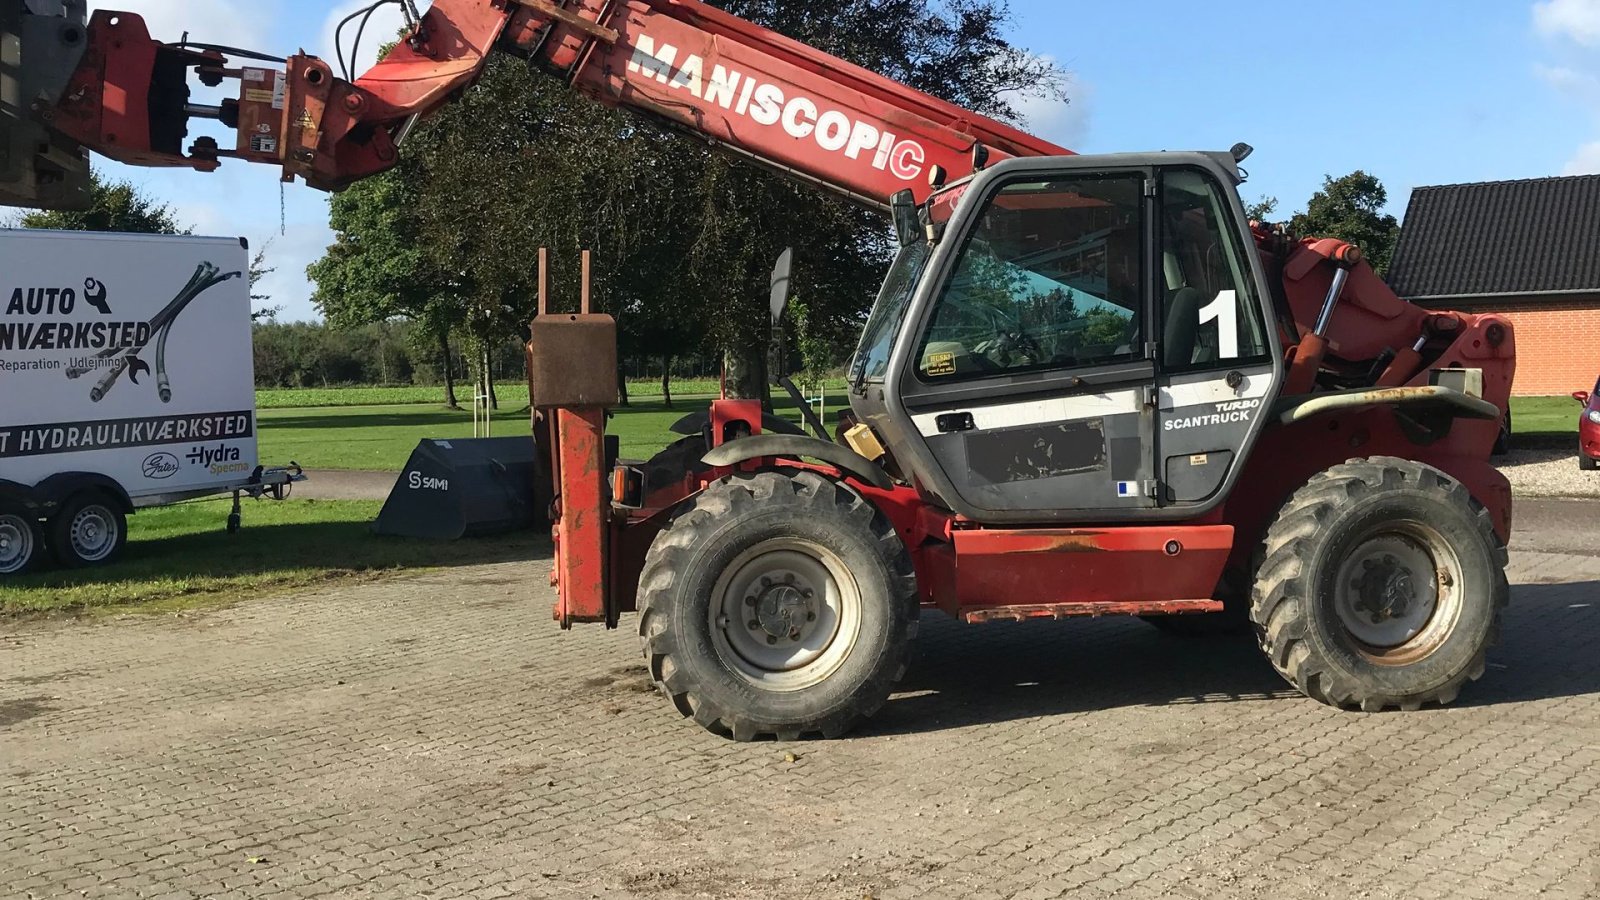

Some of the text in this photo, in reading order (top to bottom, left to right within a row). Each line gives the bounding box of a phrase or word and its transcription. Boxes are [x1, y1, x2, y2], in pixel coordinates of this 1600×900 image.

[628, 34, 925, 180] MANISCOPIC
[6, 288, 76, 315] AUTO
[1199, 290, 1238, 359] 1
[0, 356, 121, 373] Reparation Udlejning
[1215, 399, 1260, 412] TURBO
[1164, 410, 1250, 430] SCANTRUCK
[19, 415, 247, 451] HYDRAULIKVÆRKSTED
[210, 462, 249, 475] Specma
